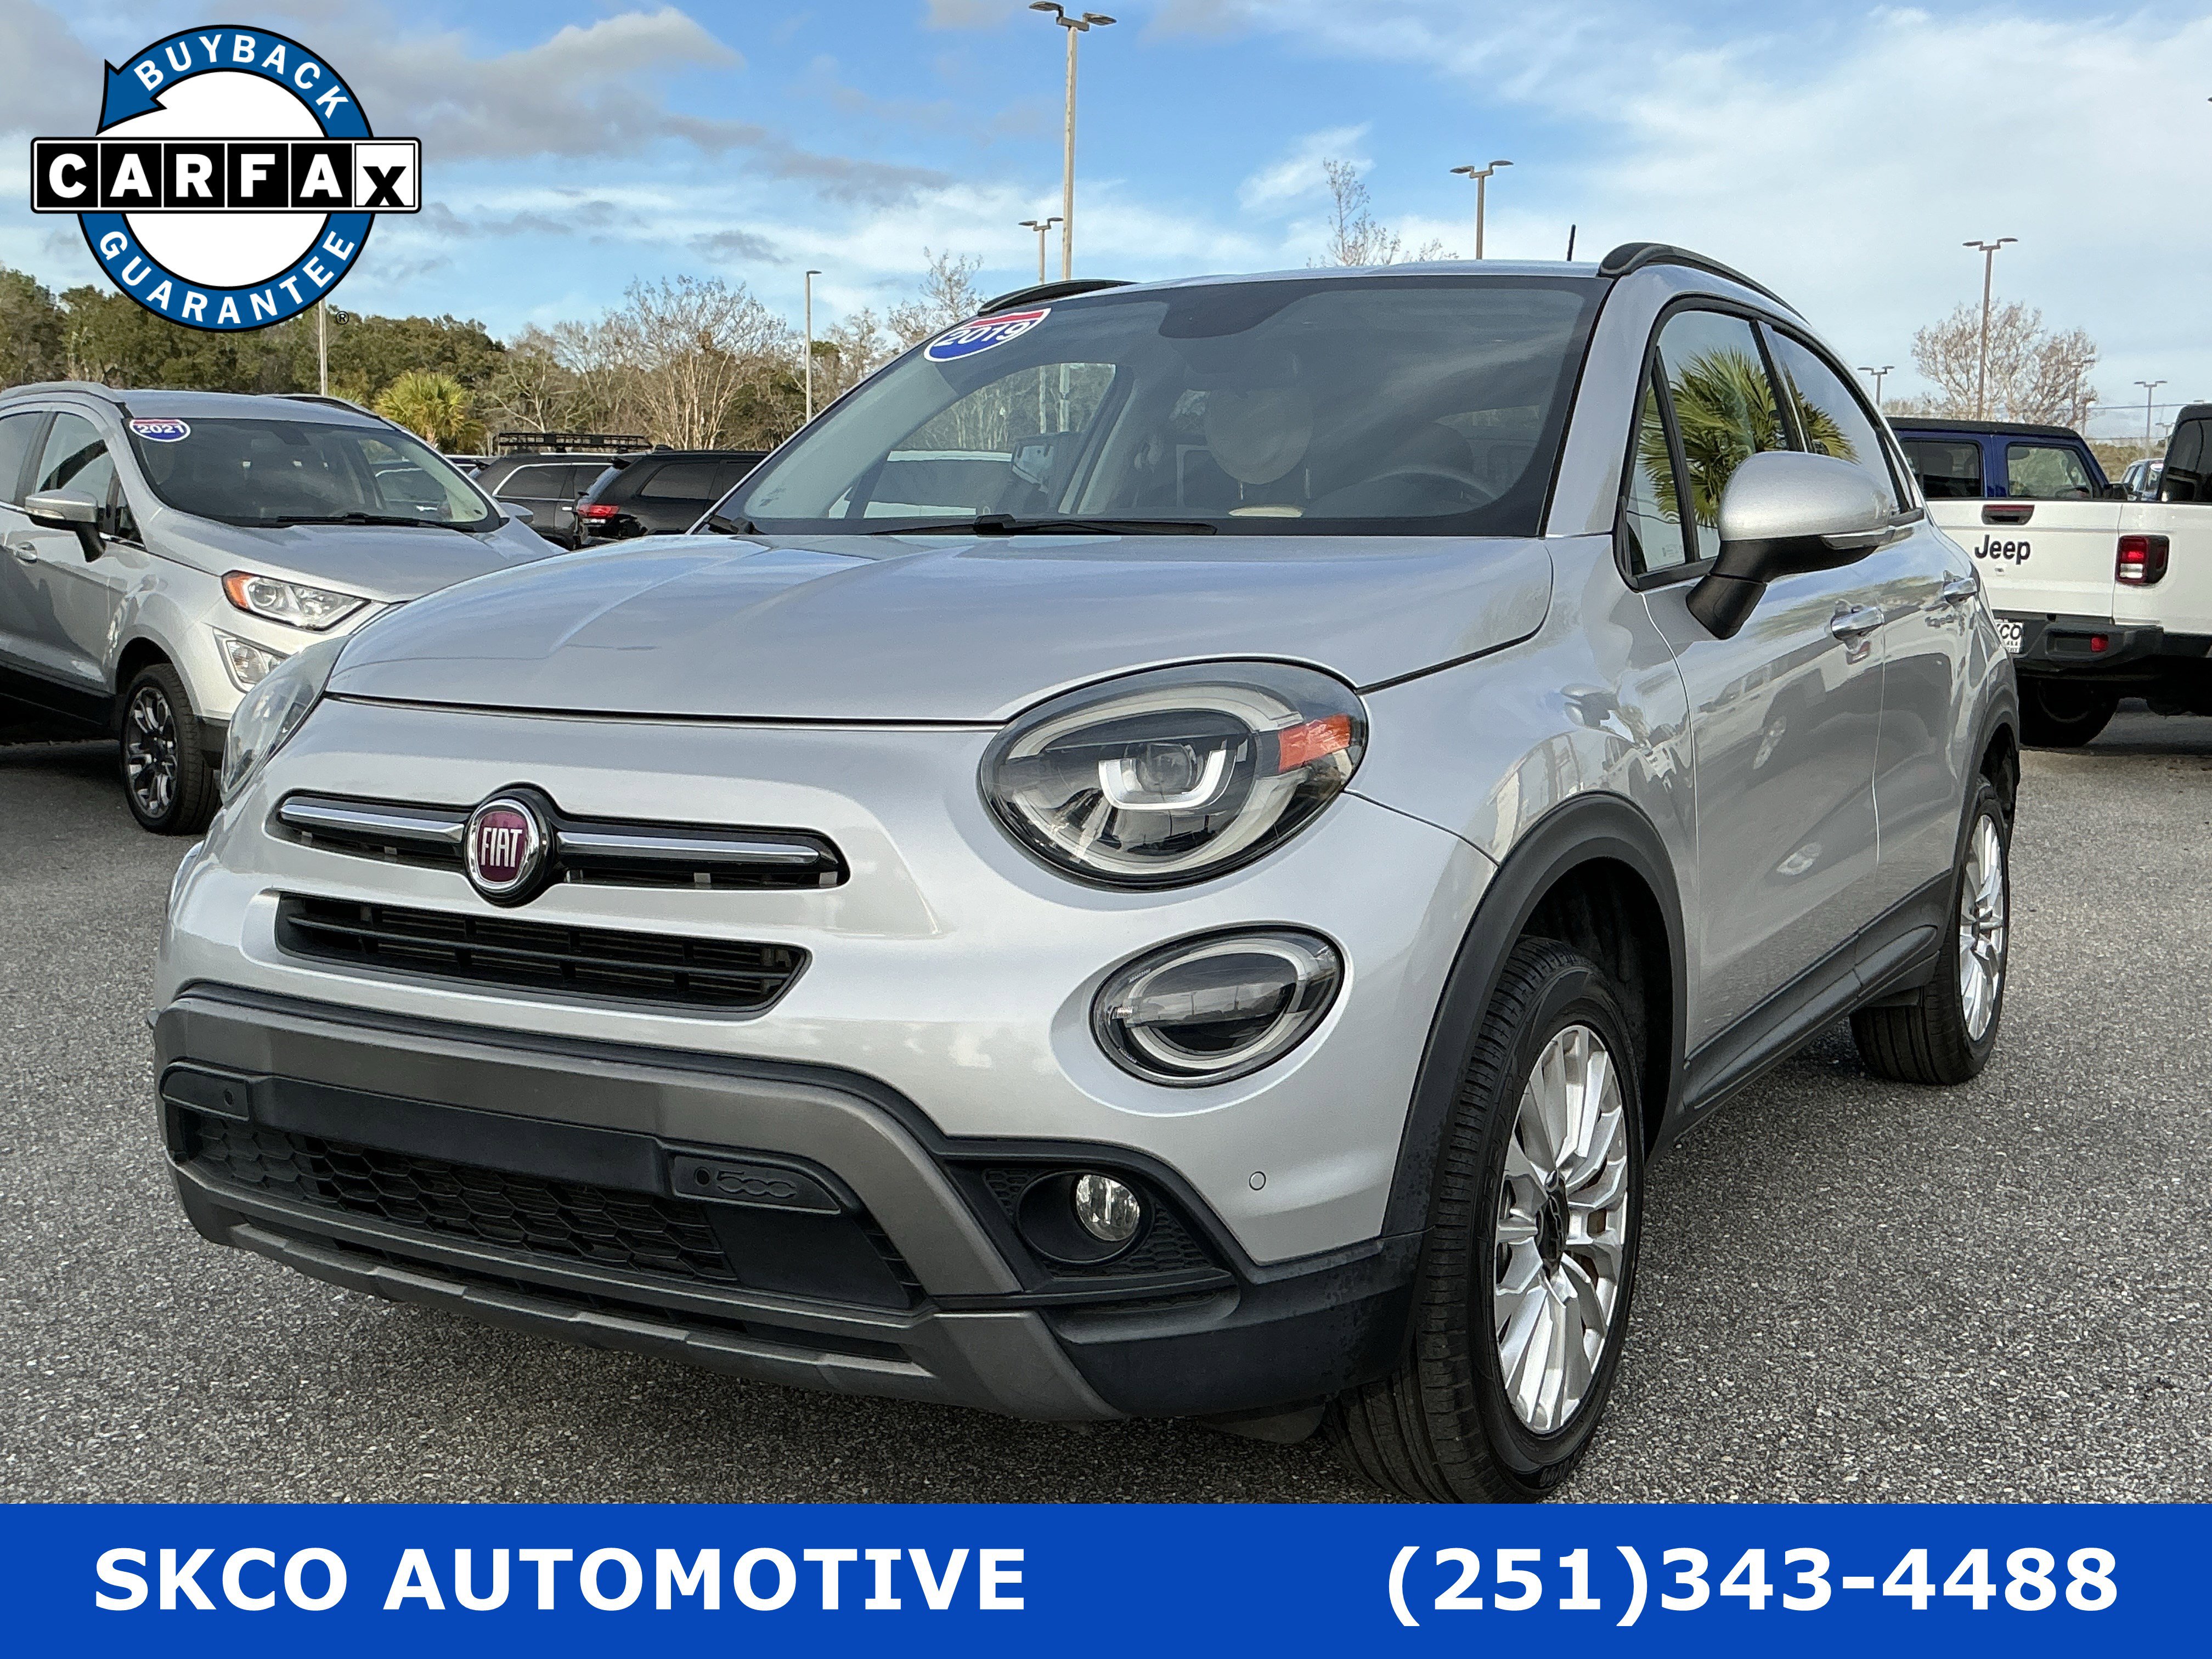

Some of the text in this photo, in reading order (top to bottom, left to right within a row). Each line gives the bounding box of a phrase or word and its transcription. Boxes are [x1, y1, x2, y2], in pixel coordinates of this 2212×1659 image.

[933, 320, 1031, 347] 2019
[137, 424, 185, 433] 2021
[1974, 534, 2031, 566] Jeep
[1997, 623, 2023, 641] CO
[480, 827, 523, 868] FIAT
[716, 1169, 798, 1199] 500
